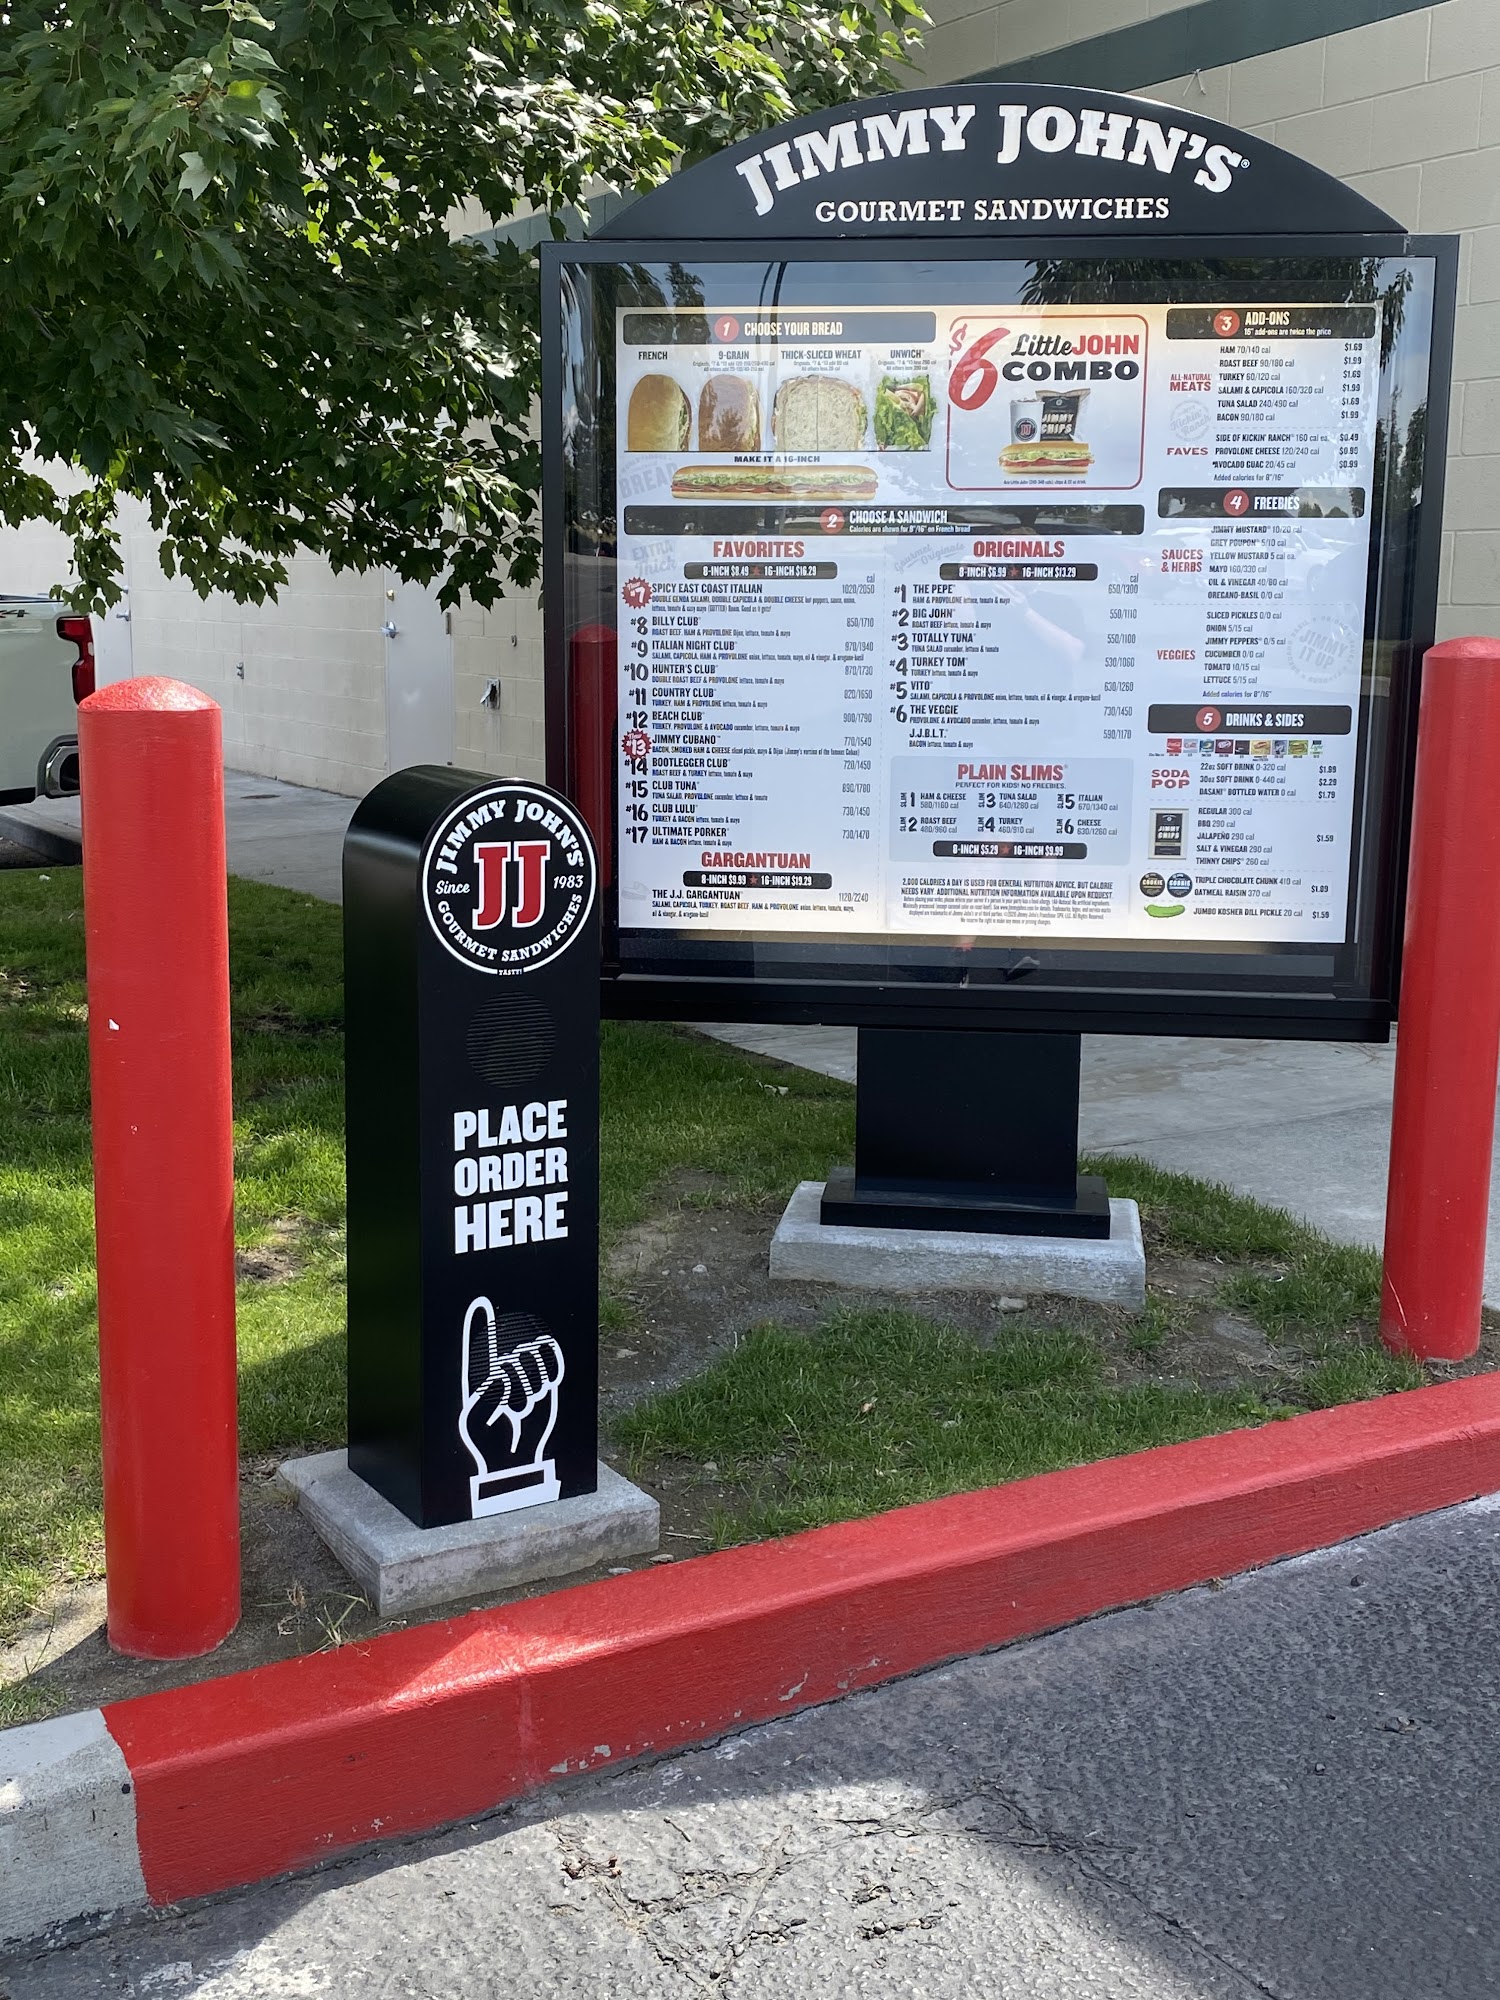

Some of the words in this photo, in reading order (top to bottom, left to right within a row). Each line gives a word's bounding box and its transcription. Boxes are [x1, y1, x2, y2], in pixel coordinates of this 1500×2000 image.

[736, 105, 976, 217] JIMMY
[815, 201, 965, 223] GOURMET
[974, 198, 1170, 220] SANDWICHES
[1222, 316, 1232, 331] 3
[1245, 312, 1290, 325] ADD-ONS
[745, 323, 782, 336] CHOOSE
[784, 323, 810, 335] YOUR
[812, 322, 843, 335] BREAD
[1317, 329, 1331, 337] price
[1072, 335, 1139, 355] JOHN
[1237, 346, 1260, 354] 70/140
[1344, 343, 1362, 352] $1.69
[638, 351, 668, 360] FRENCH
[718, 351, 749, 360] 9-GRAIN
[781, 350, 833, 360] THICK-SLICED
[834, 350, 861, 359] WHEAT
[1002, 360, 1140, 381] COMBO
[1170, 382, 1211, 391] MEATS
[1042, 414, 1074, 423] JIMMY
[1341, 411, 1359, 419] $1.99
[1041, 423, 1072, 434] CHIPS
[1230, 496, 1242, 510] 4
[1254, 497, 1300, 510] FREEBIES
[827, 514, 837, 528] 2
[850, 510, 887, 523] CHOOSE
[888, 511, 895, 523] A
[898, 510, 947, 523] SANDWICH
[713, 541, 805, 557] FAVORITES
[973, 541, 1065, 557] ORIGINALS
[1162, 550, 1203, 559] SAUCES
[703, 566, 730, 576] 8-INCH
[731, 566, 749, 576] $8.49
[764, 566, 794, 576] 16-INCH
[796, 566, 817, 576] $16.29
[959, 567, 986, 577] 8-INCH
[988, 567, 1006, 577] $6.99
[1022, 567, 1053, 577] 16-INCH
[1055, 567, 1076, 578] $13.29
[1161, 562, 1169, 572] &
[1171, 562, 1202, 572] HERBS
[652, 584, 677, 593] SPICY
[679, 584, 699, 593] EAST
[701, 585, 729, 593] COAST
[731, 585, 762, 593] ITALIAN
[914, 585, 930, 593] THE
[892, 608, 909, 626] #2
[912, 609, 926, 618] BIG
[630, 616, 648, 635] #8
[652, 617, 675, 626] BILLY
[891, 633, 908, 651] #3
[912, 633, 949, 642] TOTALLY
[631, 640, 648, 658] #9
[652, 641, 684, 650] ITALIAN
[686, 641, 711, 650] NIGHT
[1157, 650, 1195, 660] VEGGIES
[890, 658, 908, 676] #4
[911, 658, 944, 666] TURKEY
[624, 663, 648, 681] #10
[652, 665, 692, 674] HUNTER'S
[629, 688, 646, 705] #11
[652, 688, 691, 697] COUNTRY
[890, 682, 907, 699] #5
[652, 711, 679, 720] BEACH
[890, 705, 907, 723] #6
[911, 705, 927, 714] THE
[929, 705, 958, 714] VEGGIE
[626, 711, 648, 728] #12
[1203, 713, 1212, 724] 5
[1226, 713, 1262, 726] DRINKS
[1265, 714, 1274, 726] &
[1276, 714, 1304, 727] SIDES
[652, 735, 680, 744] JIMMY
[625, 758, 648, 775] #14
[652, 758, 705, 767] BOOTLEGGER
[958, 764, 1006, 780] PLAIN
[1152, 769, 1190, 778] SODA
[626, 781, 648, 798] #15
[652, 781, 673, 790] CLUB
[1152, 780, 1190, 788] POP
[626, 804, 648, 822] #16
[652, 804, 673, 813] CLUB
[436, 800, 506, 874] JIMMY
[626, 827, 648, 843] #17
[652, 827, 692, 836] ULTIMATE
[953, 845, 979, 855] 8-INCH
[981, 845, 998, 855] $5.29
[1014, 845, 1044, 855] 16-INCH
[1045, 845, 1063, 856] $9.99
[701, 852, 810, 868] GARGANTUAN
[472, 841, 550, 930] JJ
[553, 875, 584, 889] 1983
[701, 875, 727, 885] 8-INCH
[728, 874, 746, 885] $9.99
[761, 875, 790, 885] 16-INCH
[792, 875, 812, 886] $19.29
[435, 880, 470, 894] Since
[652, 889, 668, 898] THE
[670, 890, 685, 898] J.J.
[438, 901, 497, 960] GOURMET
[502, 894, 582, 962] SANDWICHES
[454, 1099, 567, 1151] PLACE
[454, 1147, 568, 1197] ORDER
[455, 1191, 568, 1254] HERE
